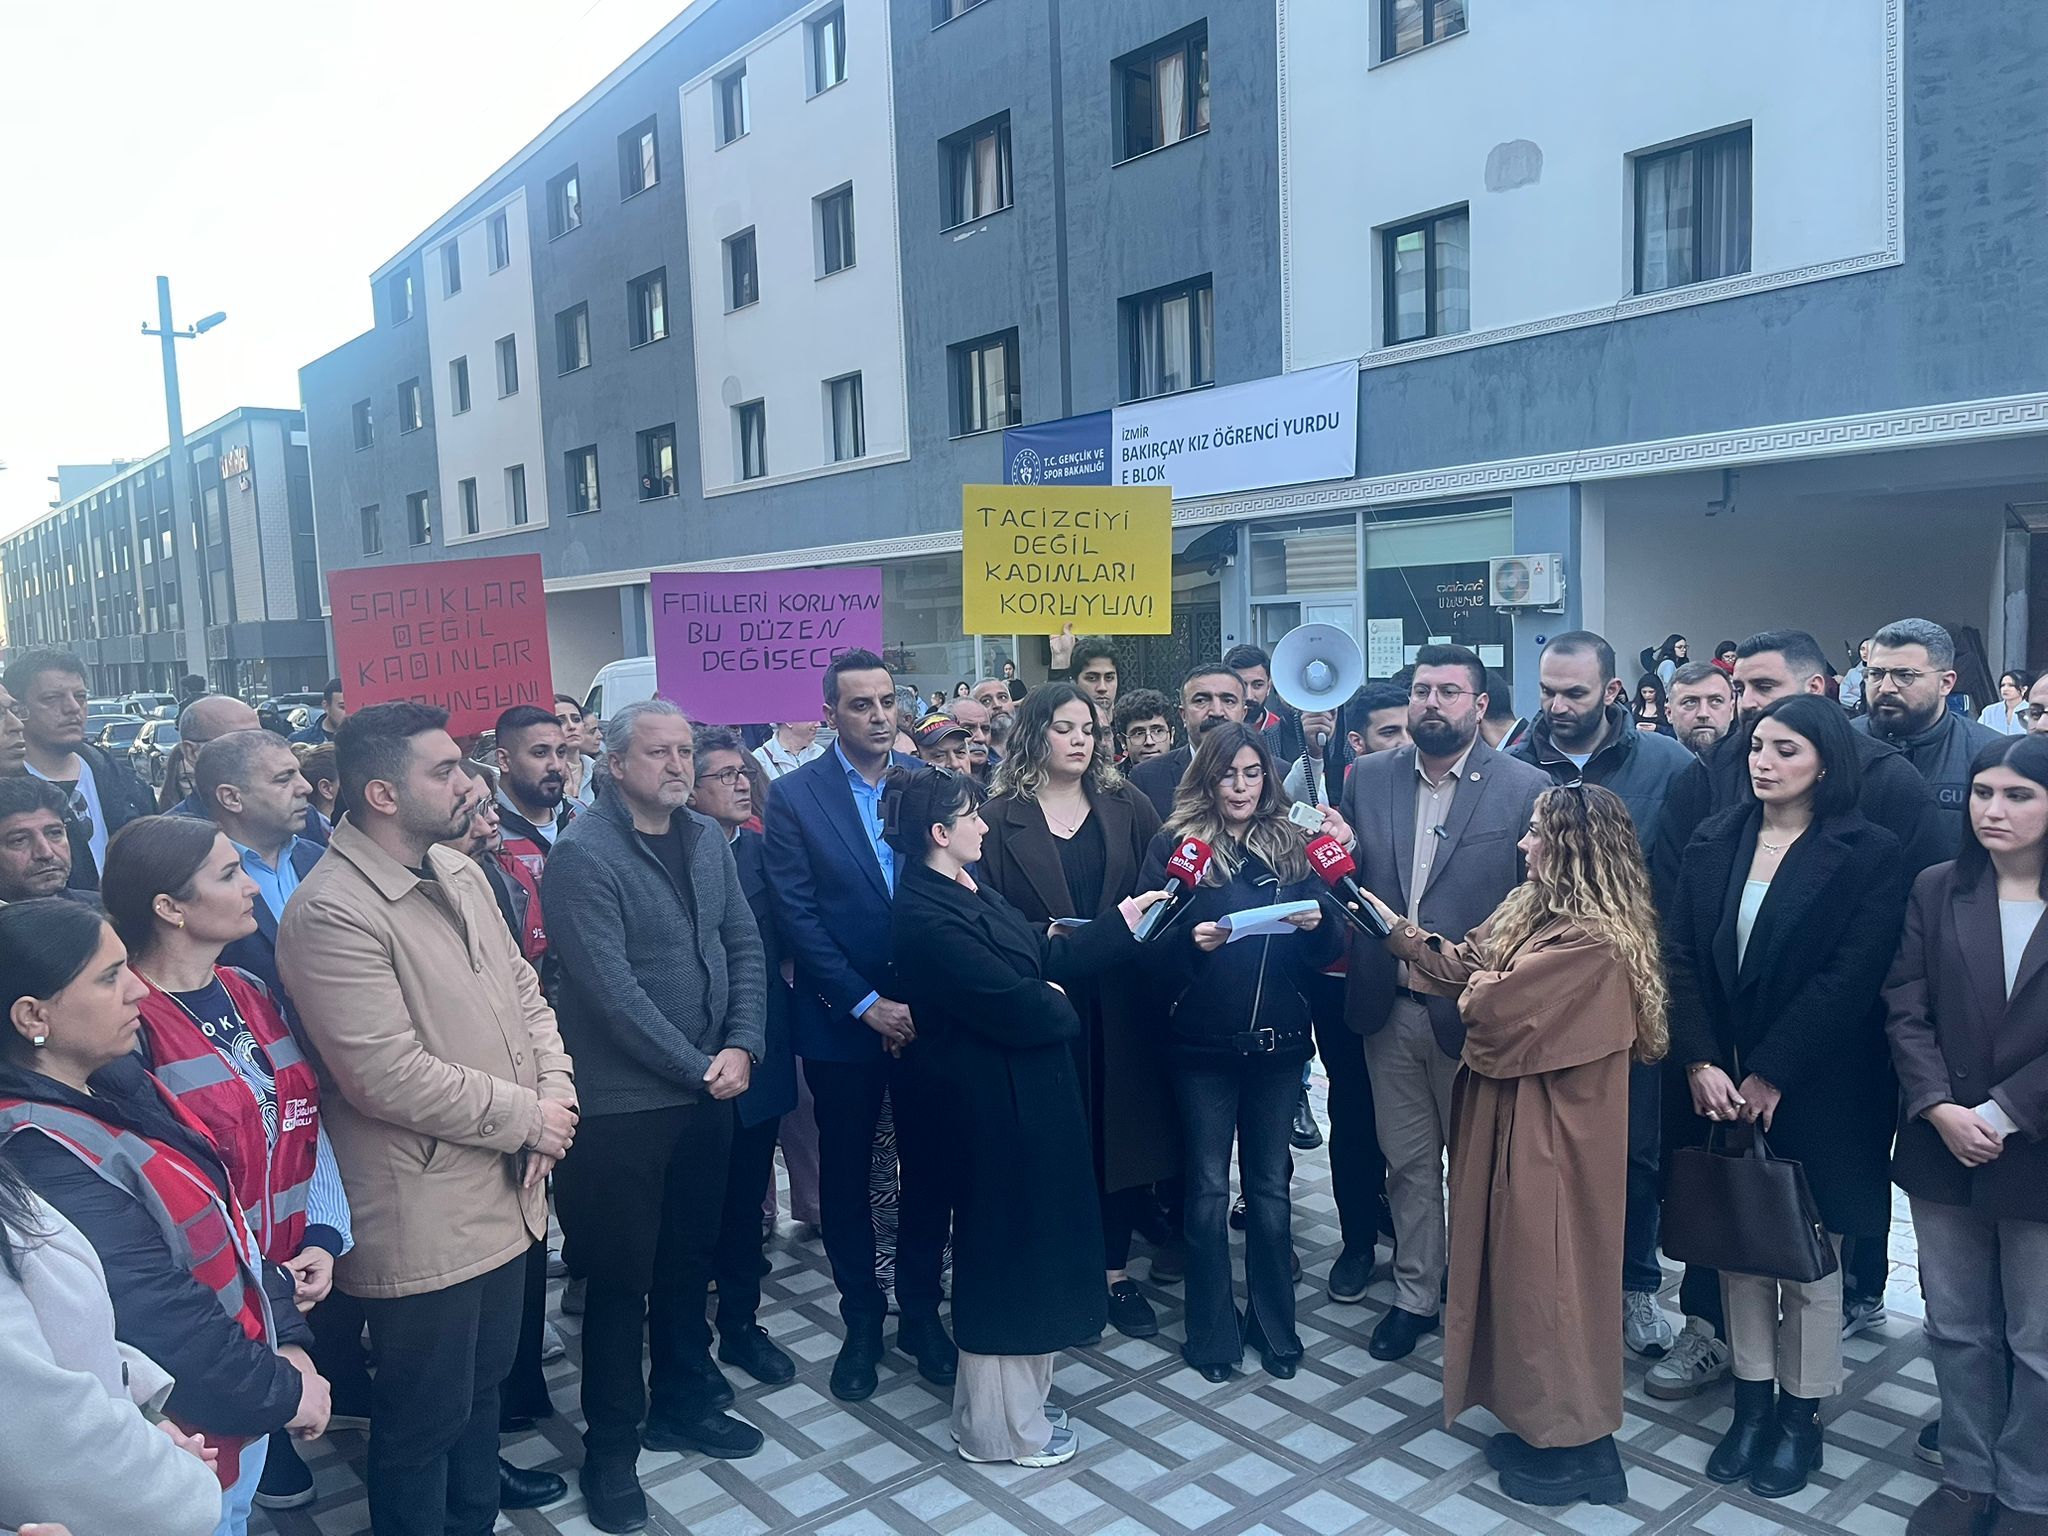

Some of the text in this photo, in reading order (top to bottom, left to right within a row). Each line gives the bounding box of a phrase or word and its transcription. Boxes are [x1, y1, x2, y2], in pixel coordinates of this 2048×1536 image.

[1121, 424, 1149, 442] İZMİR
[1121, 411, 1340, 463] BAKIRÇAY KIZ ÖĞRENCİ YURDU
[1043, 448, 1104, 467] T.C. GENÇLİK VE
[1043, 460, 1105, 480] SPOR BAKANLIĞI
[1121, 465, 1166, 485] E BLOK
[977, 507, 1129, 531] TACİZCİYİ
[1013, 534, 1099, 555] DEĞİL
[985, 561, 1135, 584] KADINLARI
[350, 580, 527, 623] SAPIKLAR
[663, 591, 881, 615] FAİLLERİ KORUYAN
[1000, 593, 1153, 618] KORUYUN!
[392, 614, 495, 649] DEĞİL
[688, 617, 846, 644] BU DÜZEN
[358, 639, 533, 688] KADINLAR
